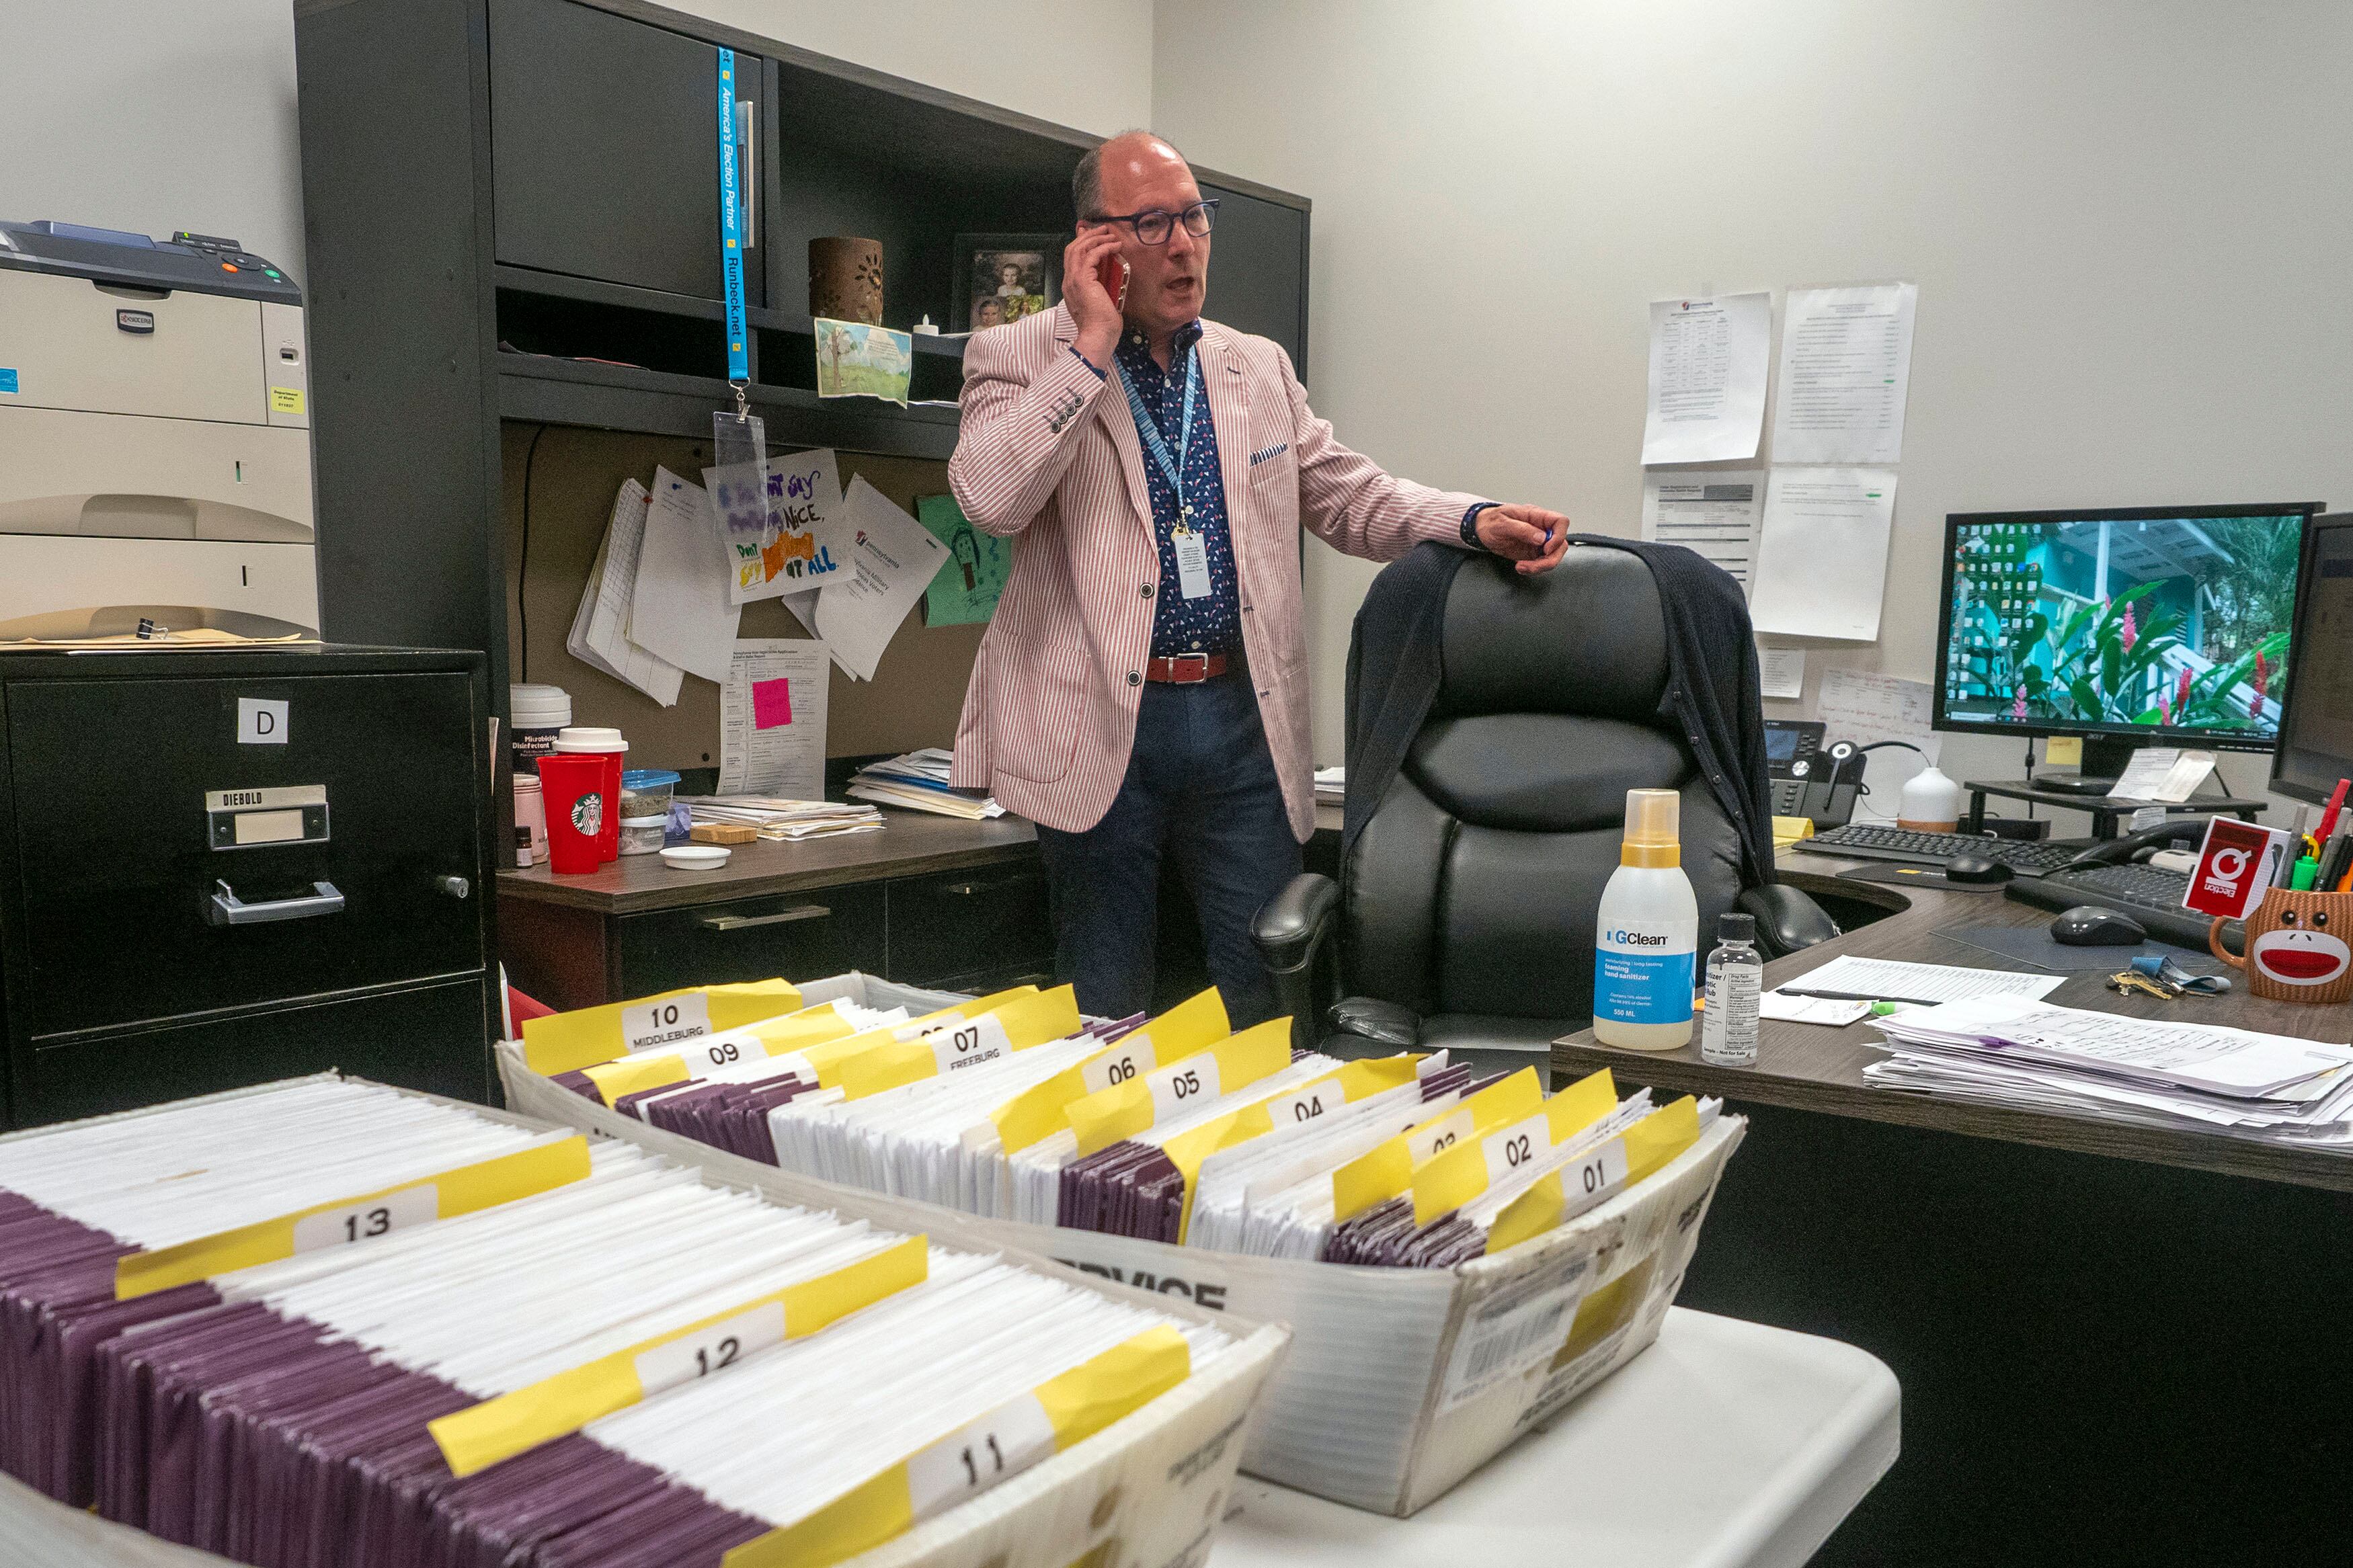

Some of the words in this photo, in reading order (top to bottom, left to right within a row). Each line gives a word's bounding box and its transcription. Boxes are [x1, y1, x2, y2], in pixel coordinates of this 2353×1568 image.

[723, 87, 732, 141] America's
[723, 144, 734, 187] Election
[725, 188, 736, 230] Partner
[728, 257, 742, 335] Runbeck.net
[257, 711, 274, 735] D
[223, 792, 262, 807] DIEBOLD
[1604, 970, 1619, 978] hand
[1605, 963, 1629, 973] foaming
[651, 1005, 679, 1028] 10
[633, 1026, 705, 1048] MIDDLEBURG
[954, 1026, 979, 1053] 07
[709, 1043, 739, 1065] 09
[950, 1047, 1000, 1071] FREEBURG
[1109, 1057, 1135, 1085] 06
[1172, 1069, 1200, 1100] 05
[1294, 1095, 1324, 1122] 04
[1506, 1133, 1533, 1167] 02
[1583, 1159, 1605, 1194] 01
[346, 1207, 390, 1242] 13
[696, 1336, 739, 1376] 12
[961, 1432, 1004, 1485] 11
